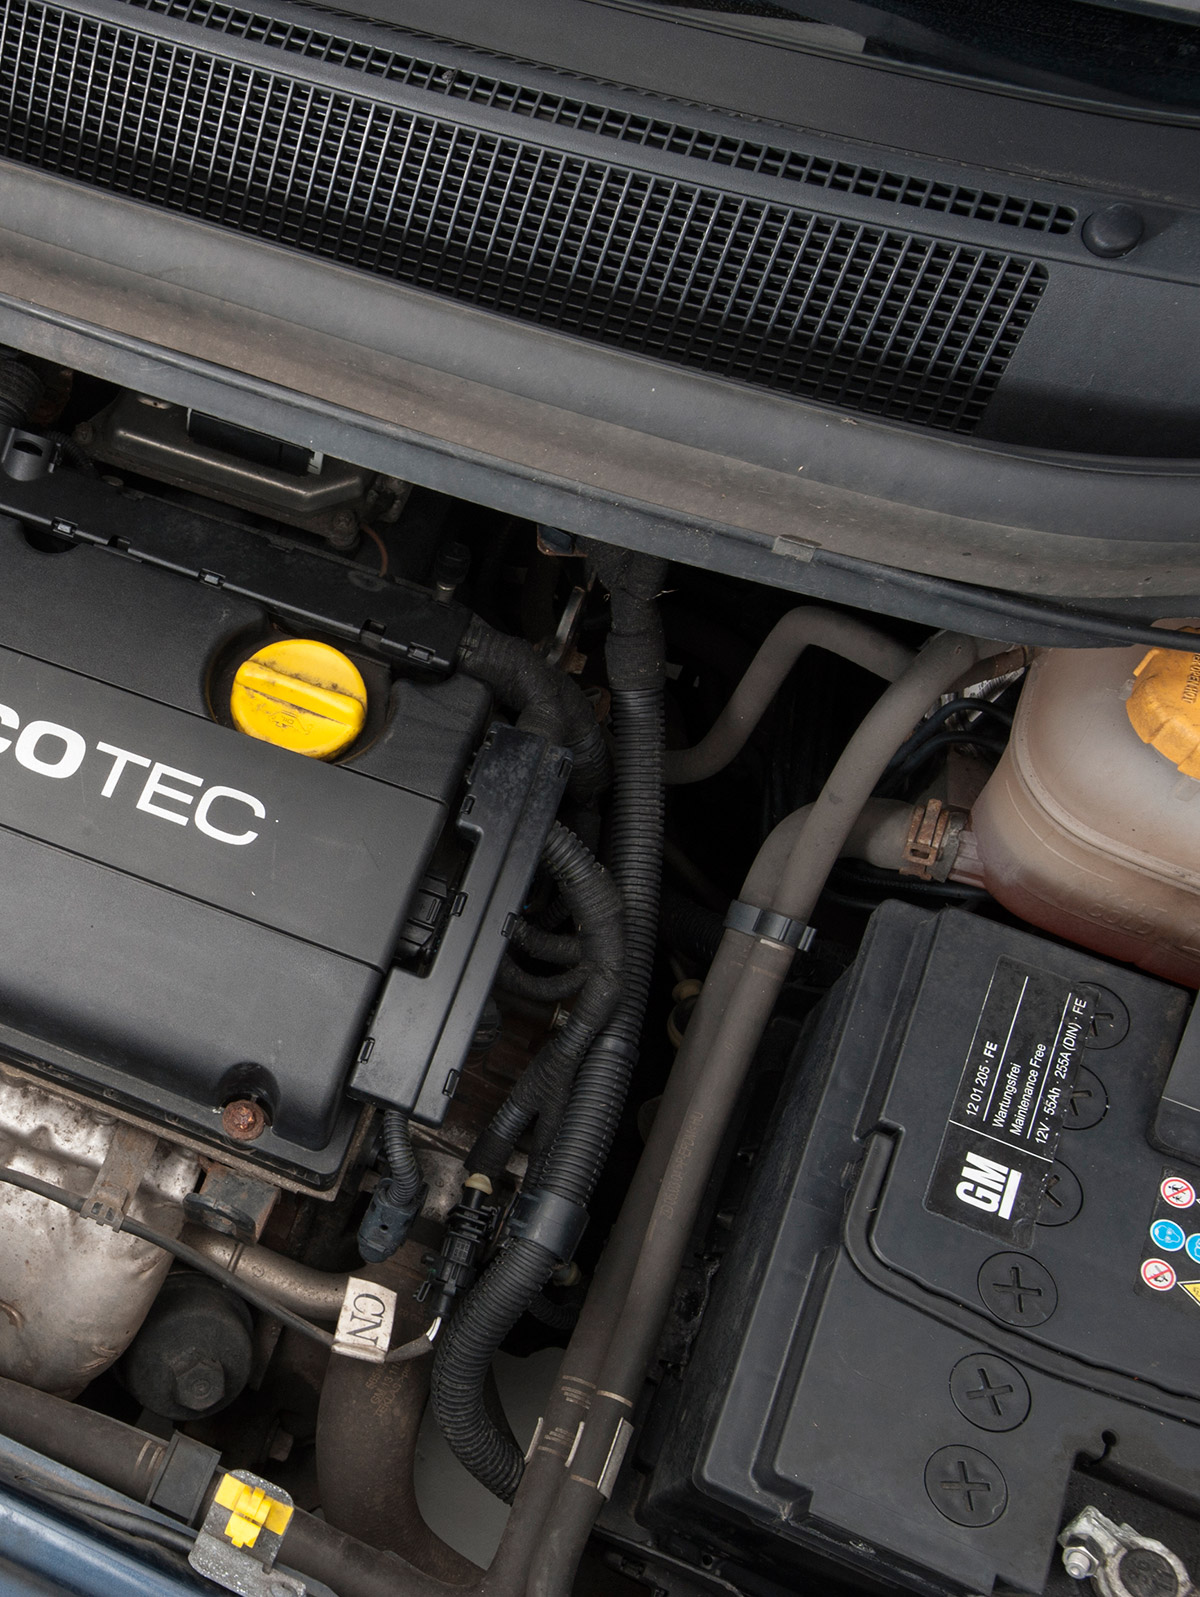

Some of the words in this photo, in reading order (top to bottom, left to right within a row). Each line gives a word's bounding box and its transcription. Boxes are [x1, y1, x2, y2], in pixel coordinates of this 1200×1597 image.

[974, 1064, 990, 1086] 205
[984, 1041, 997, 1058] FE
[1035, 1121, 1050, 1144] 12V
[1043, 1087, 1061, 1116] 55Ah
[1054, 1052, 1071, 1080] 255A
[1063, 1022, 1082, 1051] (DIN)
[1073, 997, 1087, 1015] FE
[965, 1102, 979, 1116] 12
[970, 1087, 983, 1102] 01
[991, 1062, 1022, 1128] Wartungsfrei
[1009, 1069, 1039, 1136] Maintenance
[1029, 1043, 1047, 1068] Free
[955, 1151, 1010, 1213] GM
[346, 1293, 386, 1346] CN
